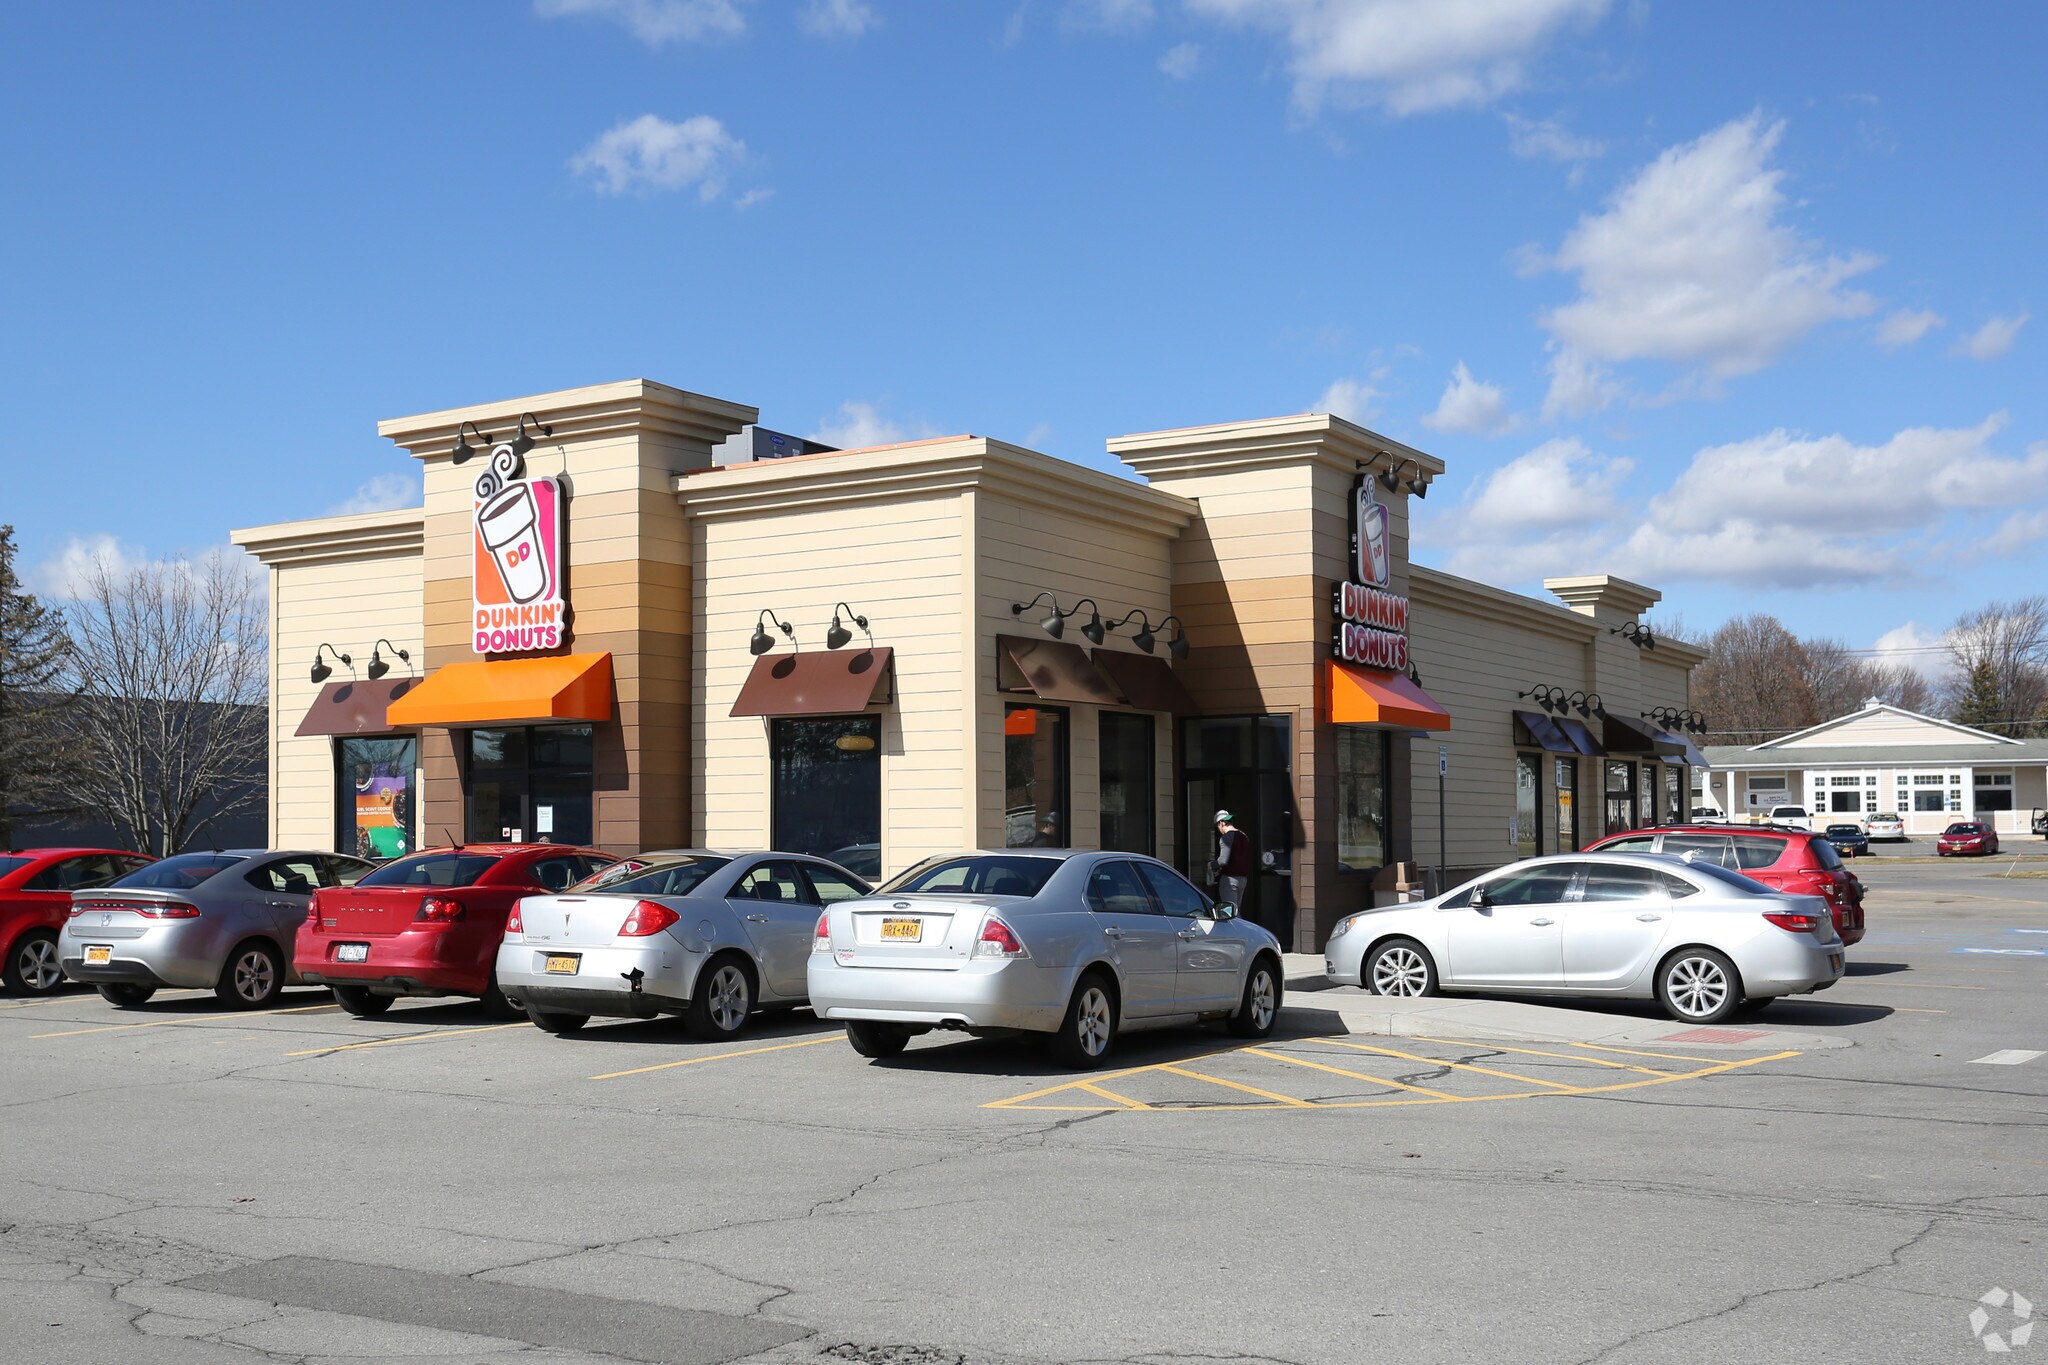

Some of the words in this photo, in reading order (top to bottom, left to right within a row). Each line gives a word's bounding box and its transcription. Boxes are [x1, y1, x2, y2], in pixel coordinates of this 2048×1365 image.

[506, 542, 531, 568] DD
[476, 603, 561, 630] DUNKIN'
[1344, 582, 1409, 630] DUNKIN'
[476, 625, 557, 651] DONUTS
[1344, 624, 1407, 669] DONUTS
